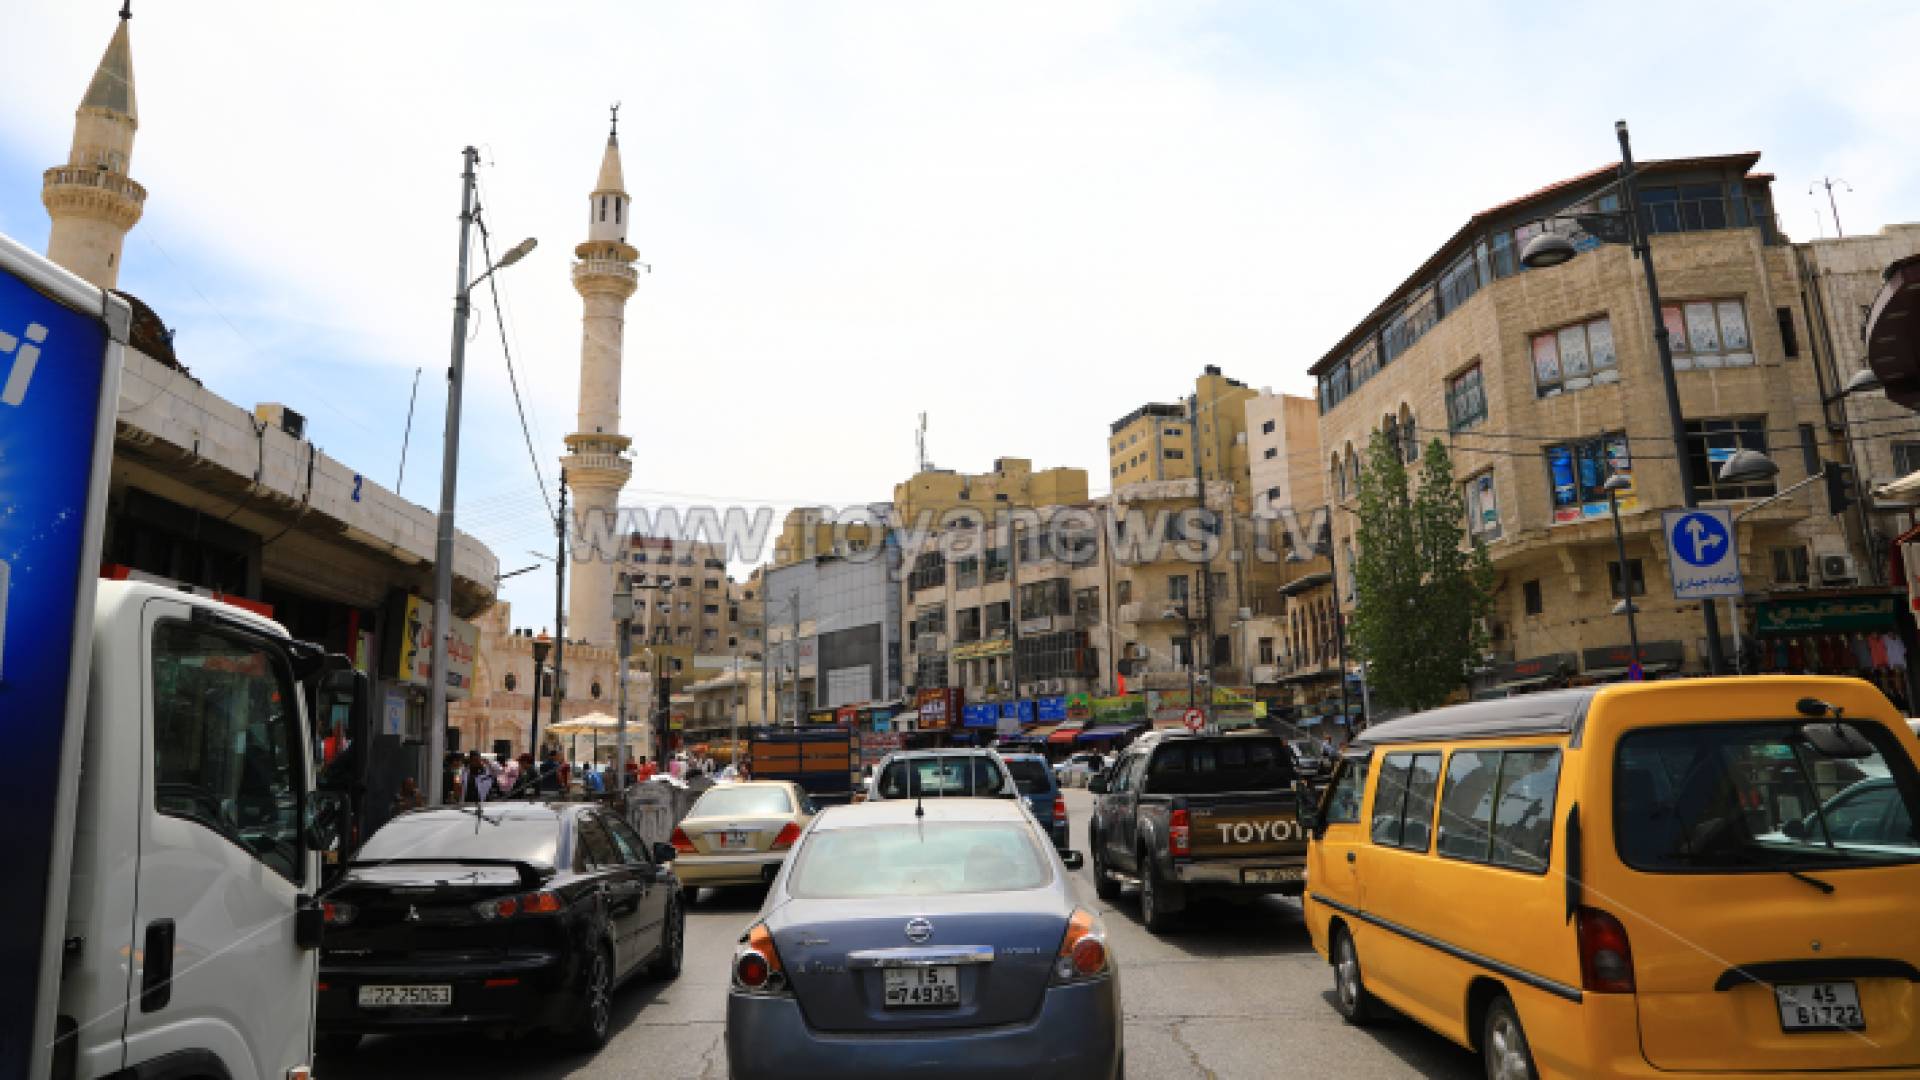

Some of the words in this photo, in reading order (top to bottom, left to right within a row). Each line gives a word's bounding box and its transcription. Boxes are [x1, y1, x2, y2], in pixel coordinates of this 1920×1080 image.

[351, 473, 364, 503] 2
[1216, 820, 1304, 844] TOYOT
[898, 985, 958, 1003] 74935
[1811, 983, 1837, 1002] 45
